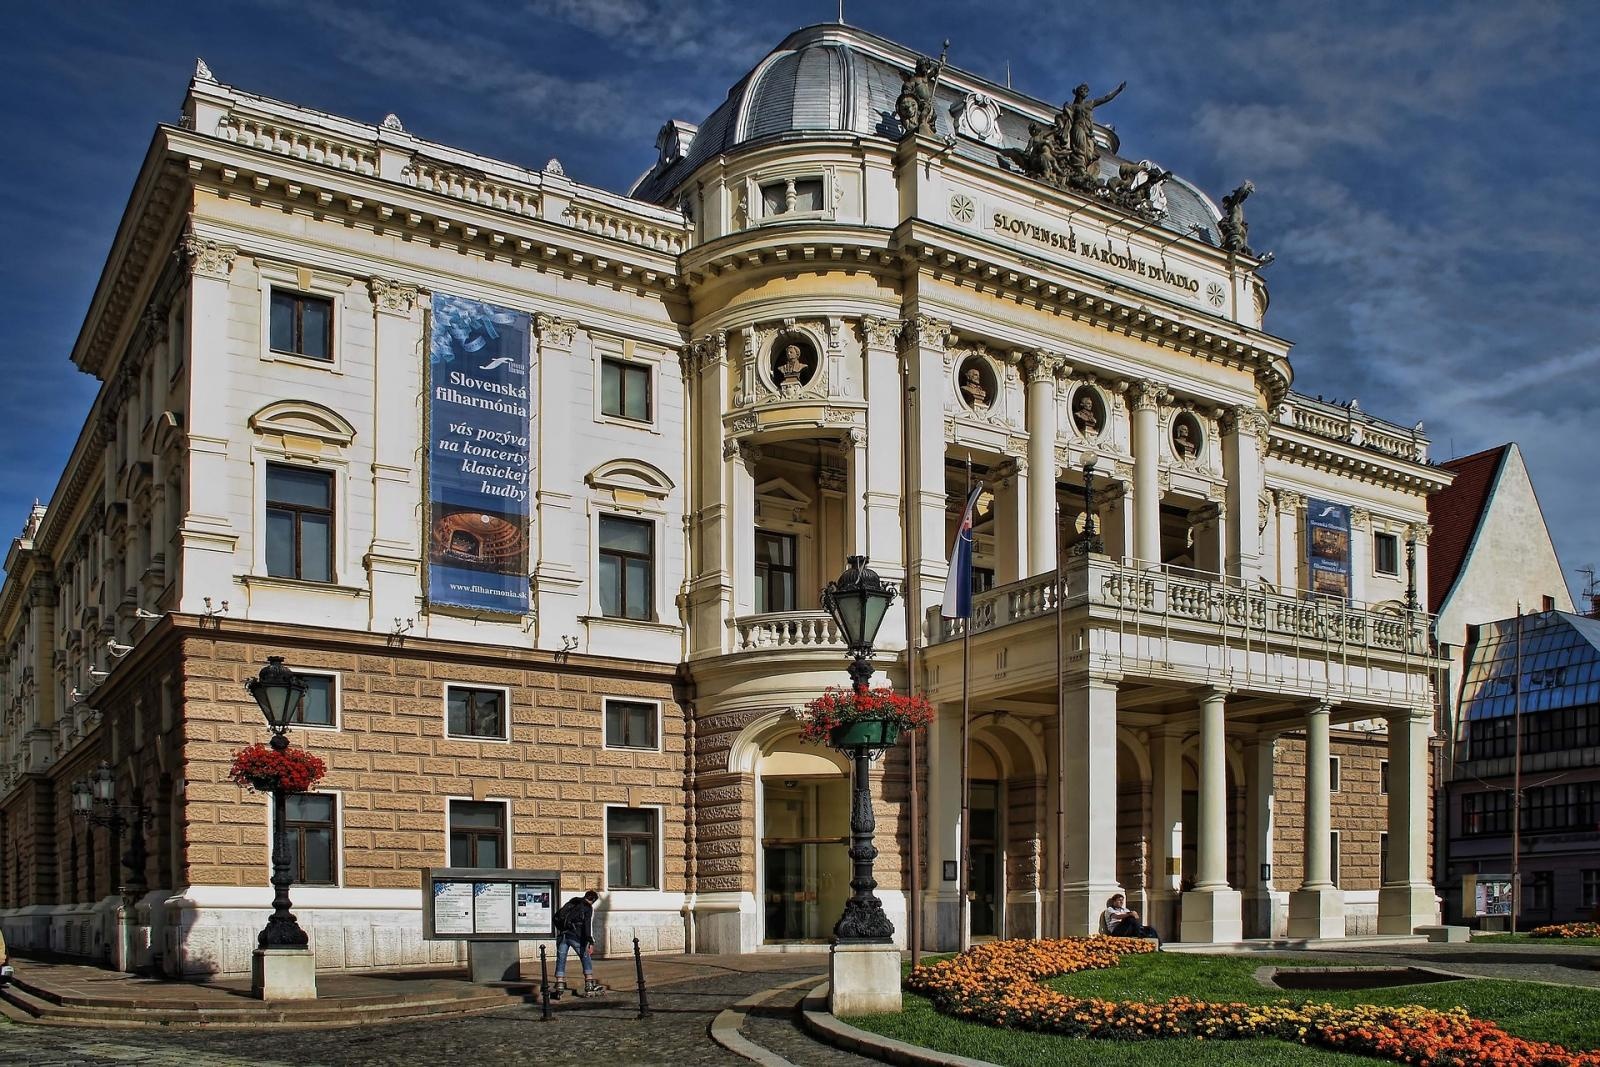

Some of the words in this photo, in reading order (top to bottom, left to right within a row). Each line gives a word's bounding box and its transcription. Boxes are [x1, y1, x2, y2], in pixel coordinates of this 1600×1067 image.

[993, 213, 1077, 253] SLOVENSKÉ
[1080, 242, 1146, 276] NÁRODNÉ
[1148, 265, 1200, 293] DIVADLO
[450, 371, 527, 399] Slovenská
[435, 386, 527, 417] filharmónia
[449, 422, 473, 436] vás
[476, 428, 527, 447] pozýva
[439, 440, 460, 452] na
[463, 441, 527, 466] koncerty
[461, 459, 527, 484] klasickej
[480, 481, 527, 502] hudby
[449, 583, 528, 599] www.filharmonia.sk
